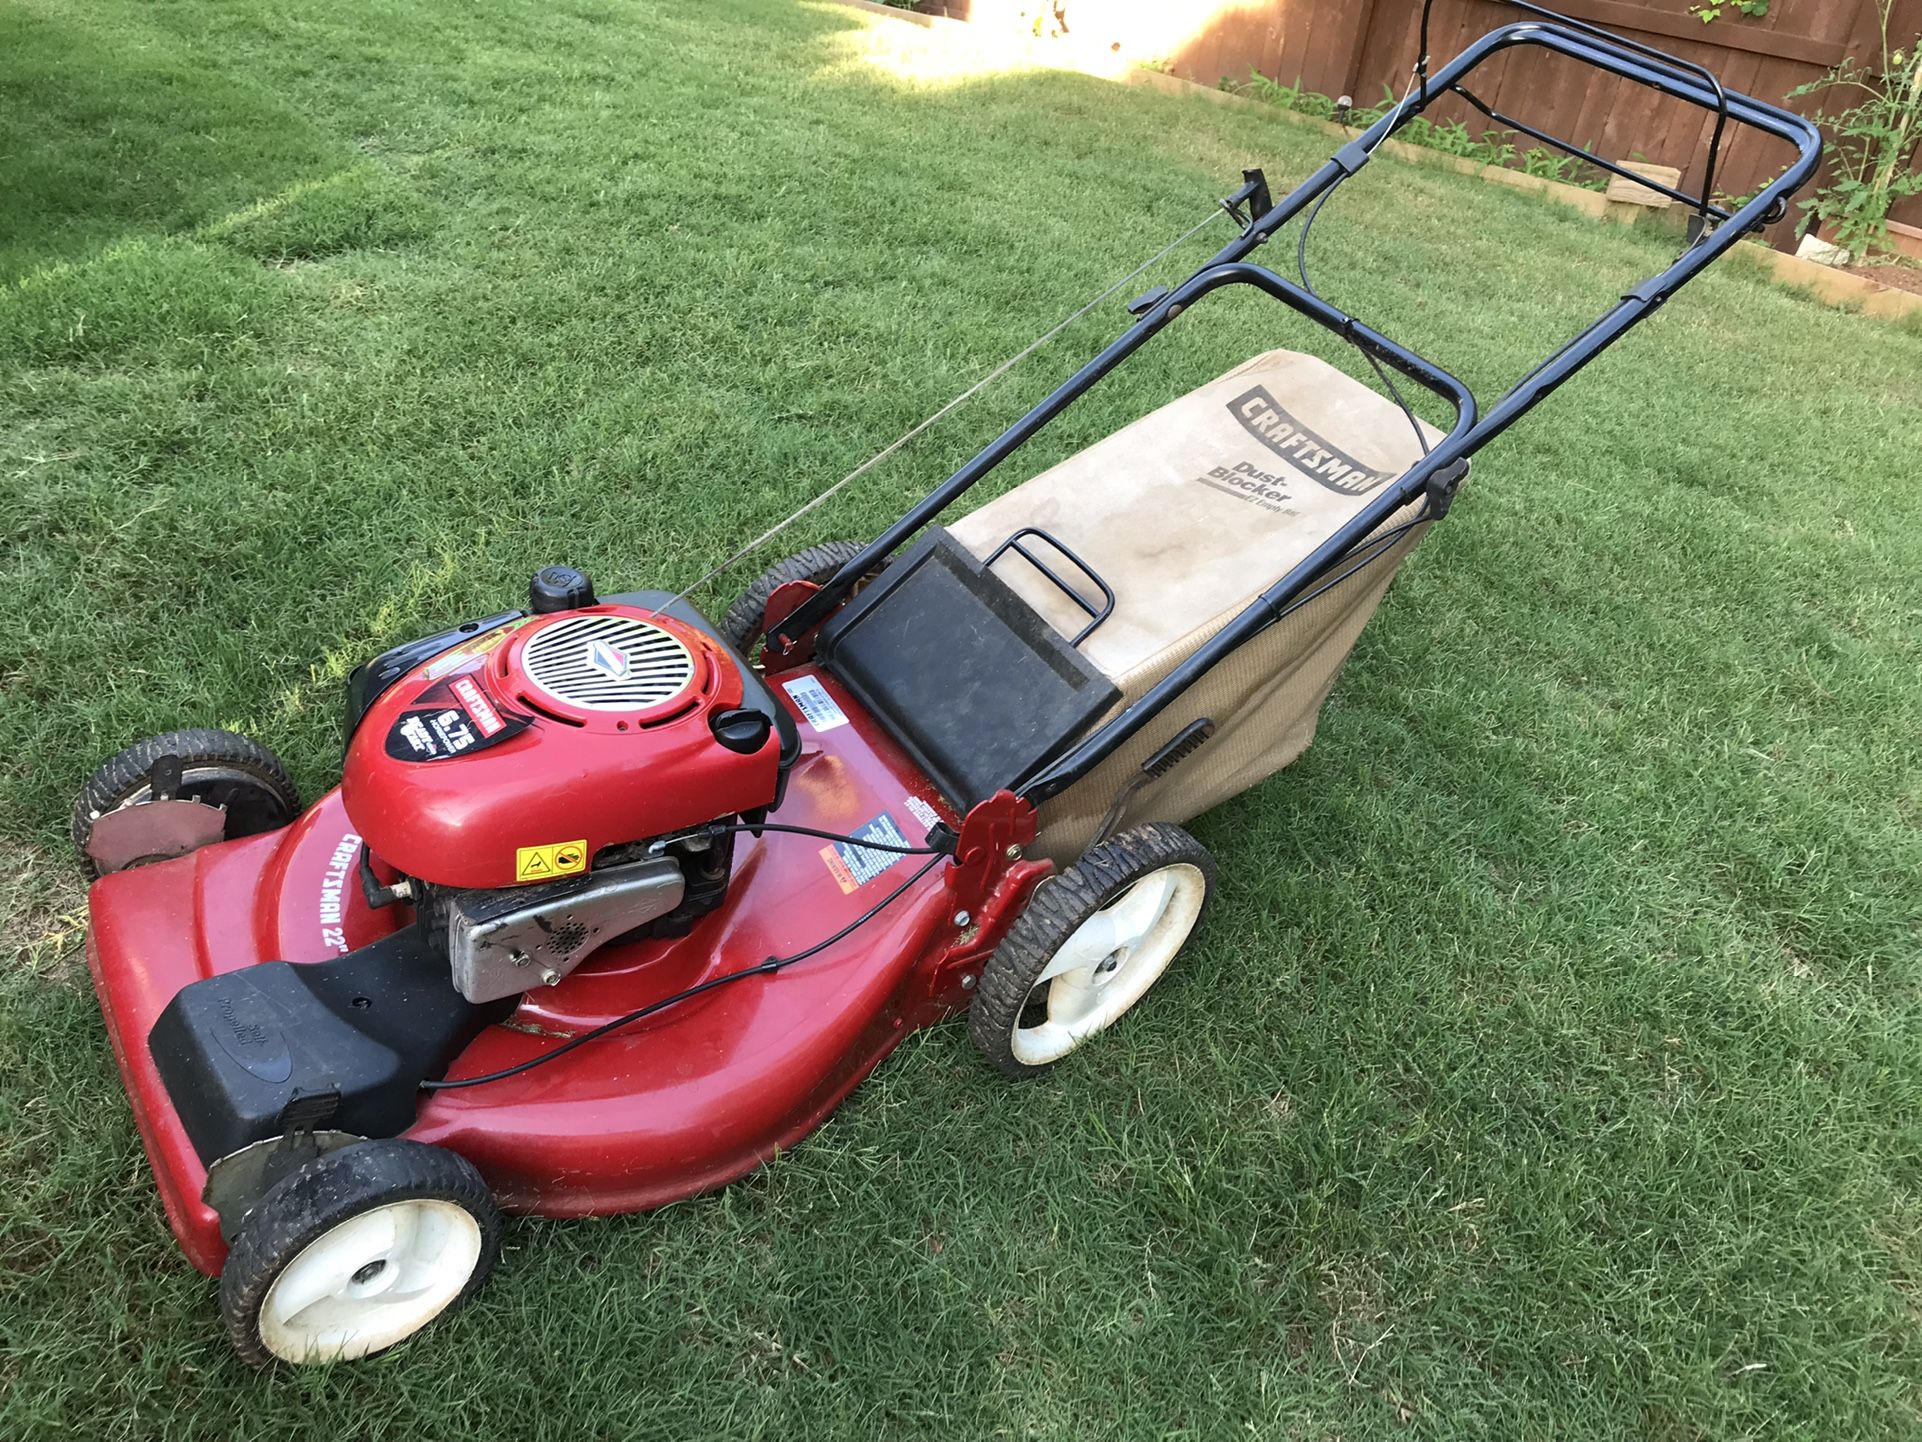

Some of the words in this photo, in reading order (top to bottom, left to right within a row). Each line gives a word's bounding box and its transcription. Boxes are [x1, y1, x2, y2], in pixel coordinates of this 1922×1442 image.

[1241, 397, 1382, 492] CRAFTSMAN
[1207, 466, 1293, 502] Blocker
[1232, 461, 1288, 487] Dust-
[455, 679, 501, 733] CRAFTSMAN
[429, 719, 457, 754] HORSEPOWER
[437, 709, 476, 751] 6.75
[319, 833, 363, 924] CRAFTSMAN
